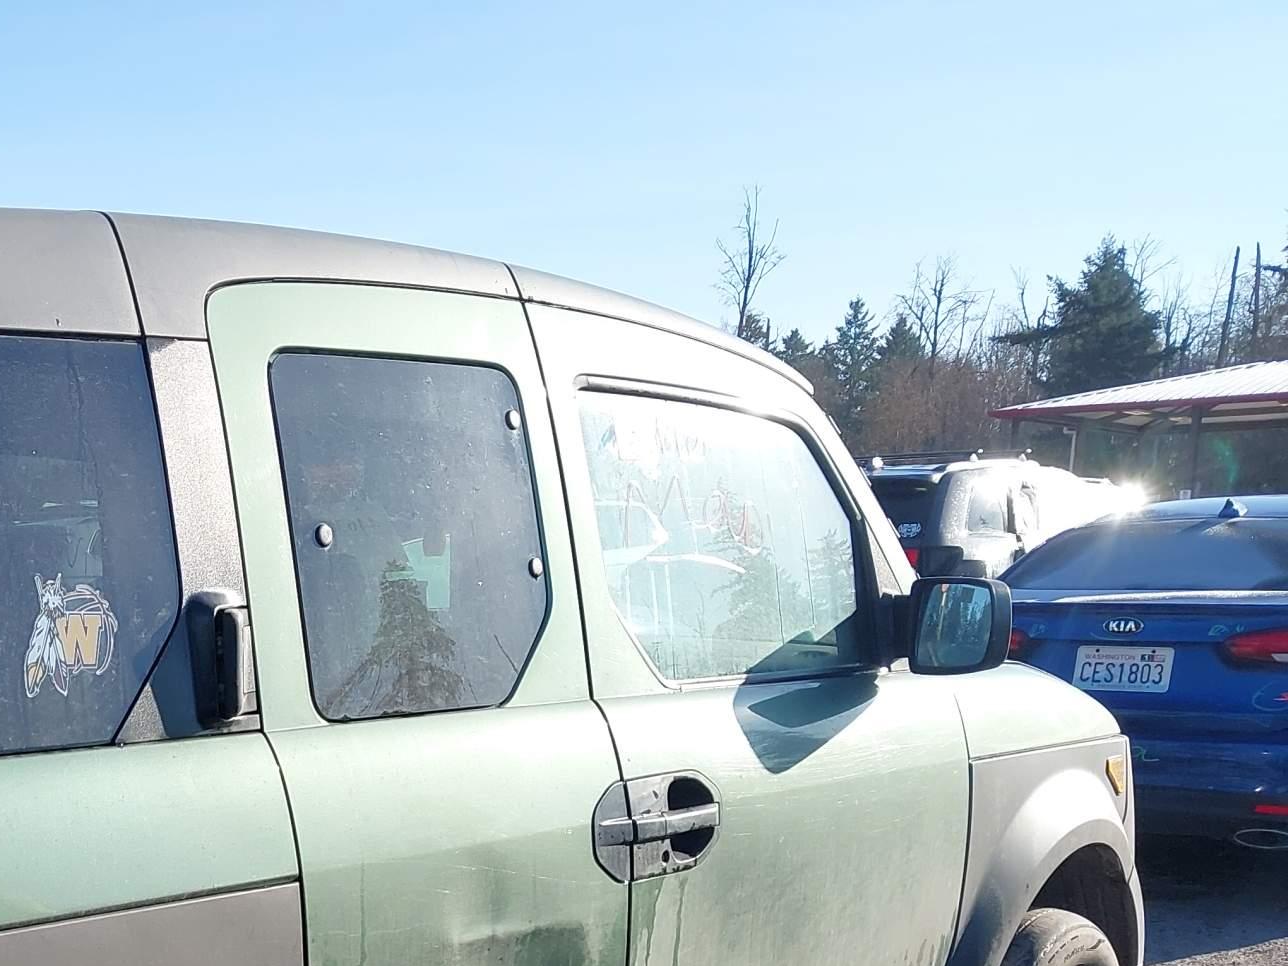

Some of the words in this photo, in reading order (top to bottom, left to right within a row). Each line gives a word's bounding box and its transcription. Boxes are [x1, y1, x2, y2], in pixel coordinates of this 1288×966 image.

[1108, 620, 1137, 632] KIA
[55, 611, 105, 669] W
[1084, 653, 1136, 661] WASHINGTON
[1079, 661, 1164, 685] CES1803
